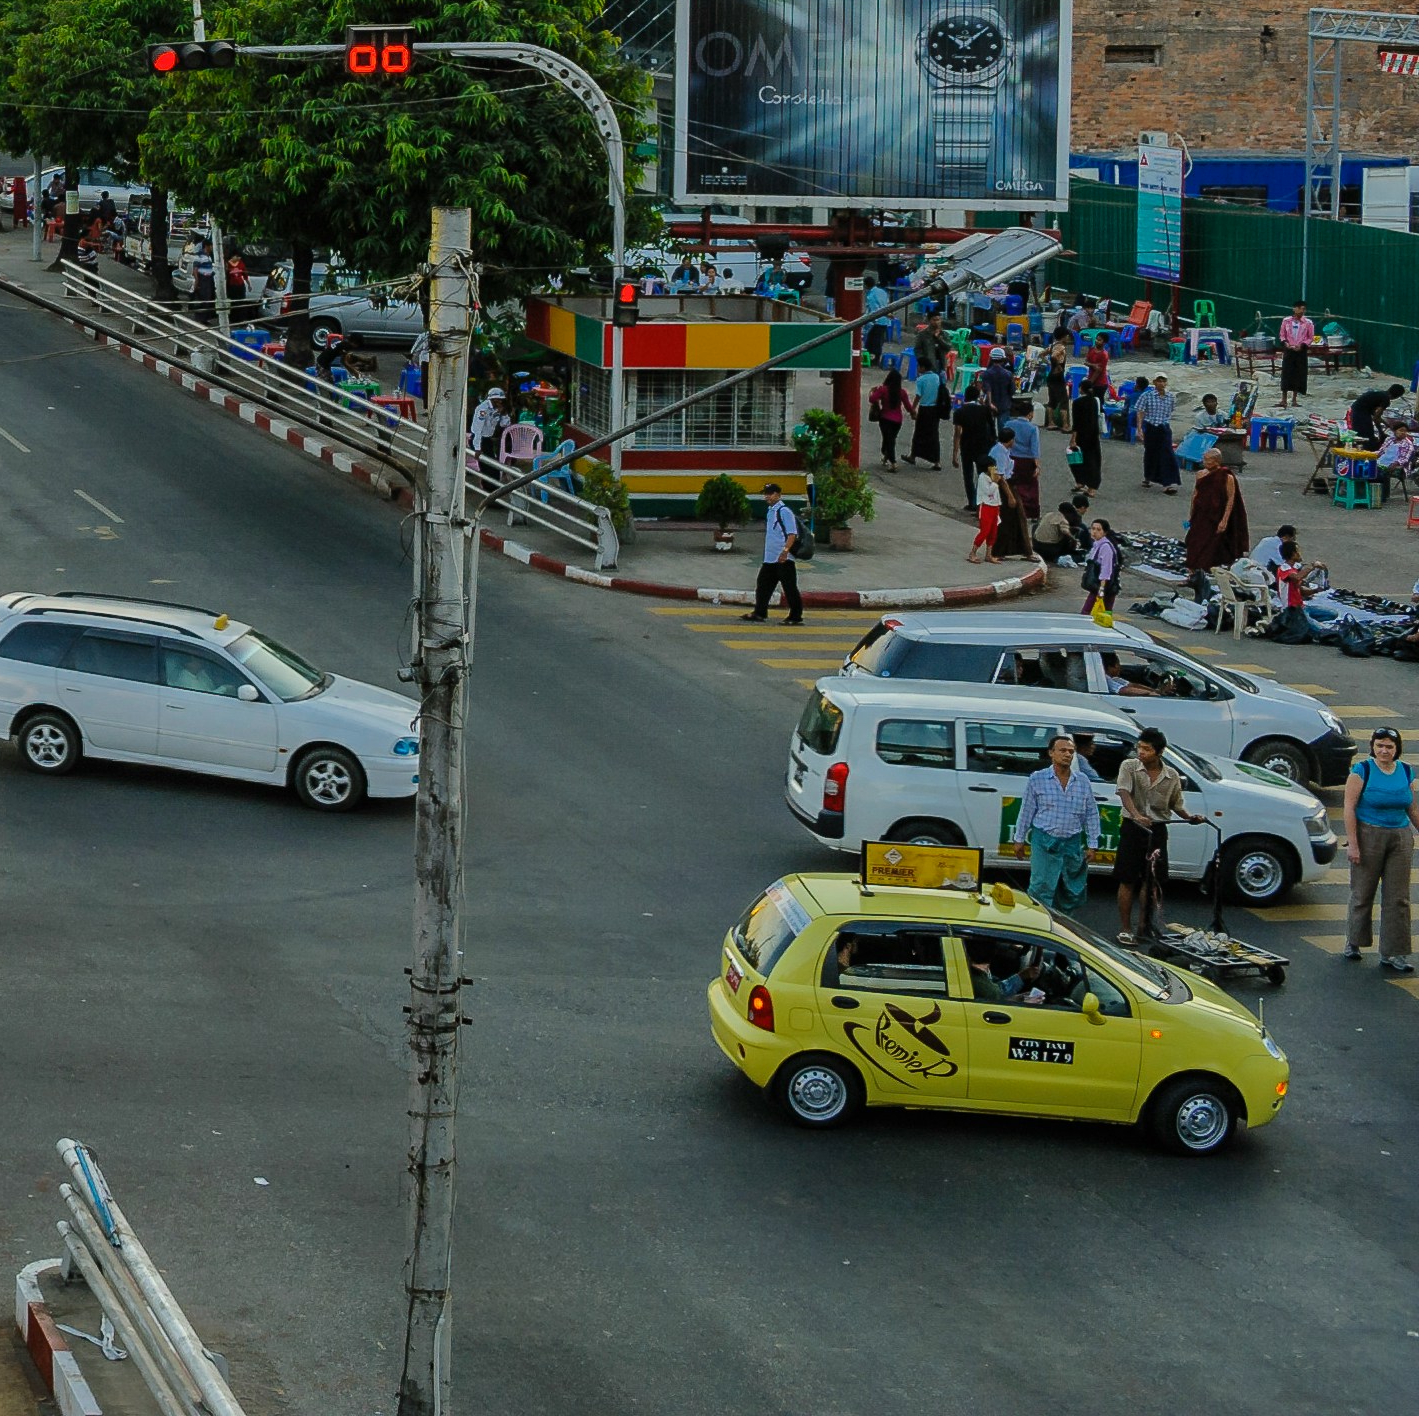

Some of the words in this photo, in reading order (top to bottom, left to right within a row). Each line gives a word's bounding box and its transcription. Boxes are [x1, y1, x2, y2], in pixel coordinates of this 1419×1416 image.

[349, 44, 409, 73] 00
[871, 866, 915, 877] PREMIER
[1018, 1039, 1041, 1048] CITY
[1045, 1041, 1067, 1050] TAXI
[1011, 1048, 1073, 1064] W-8179
